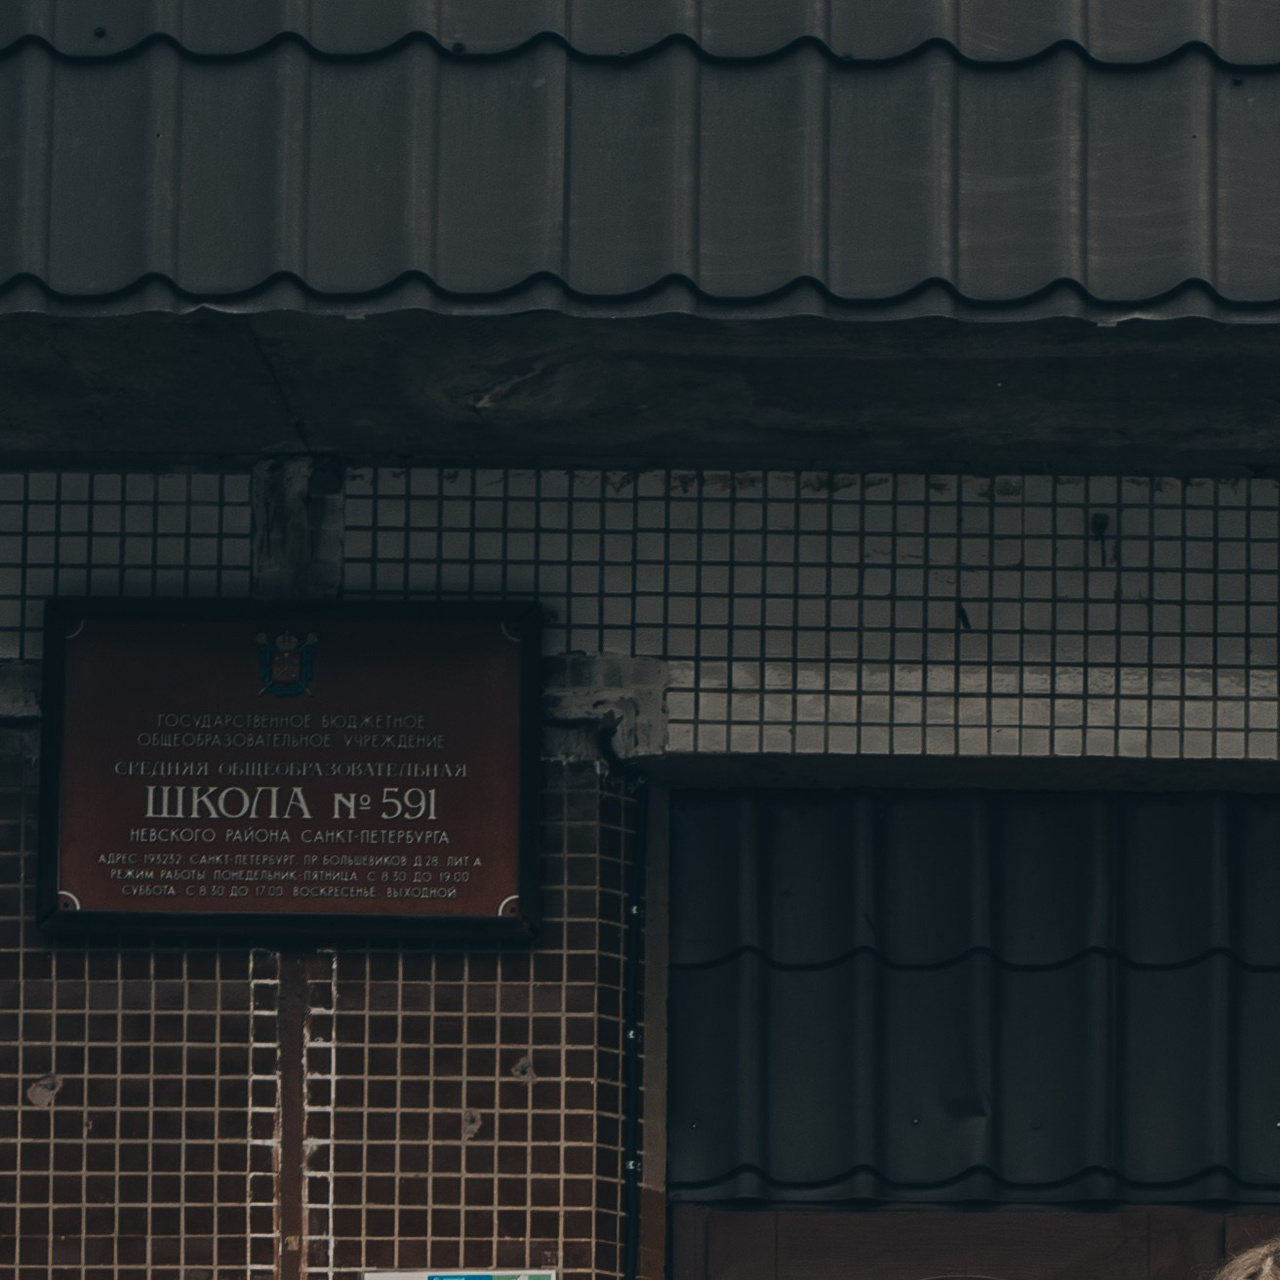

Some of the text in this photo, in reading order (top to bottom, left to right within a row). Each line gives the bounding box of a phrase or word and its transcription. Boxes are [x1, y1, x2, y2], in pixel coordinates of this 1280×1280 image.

[158, 713, 426, 729] ГОСУДАРСТВЕННОЕ БЮДЖЕТНОЕ
[137, 732, 446, 749] ОБЩЕОБРАЗОВАТЕЛЬНОЕ УЧРЕЖДЕНИЕ
[114, 761, 467, 778] СРЕДНЯЯ ОБЩЕОБРАЗОВАТЕЛЬНАЯ
[144, 785, 438, 820] ШКОЛА № 591
[130, 826, 451, 845] НЕВСКОГО РАЙОНА САНКТ-ПЕТЕРБУРГА
[98, 853, 137, 865] АДРЕС
[110, 868, 155, 880] РЕЖИМ
[160, 868, 206, 881] РАБОТЫ
[366, 870, 377, 882] С
[413, 871, 433, 883] ДО
[121, 884, 177, 896] СУББОТА
[185, 885, 196, 896] С
[230, 885, 249, 897] ДО
[292, 885, 376, 898] ВОСКРЕСЕНЬЕ
[386, 886, 458, 899] ВЫХОДНОЙ
